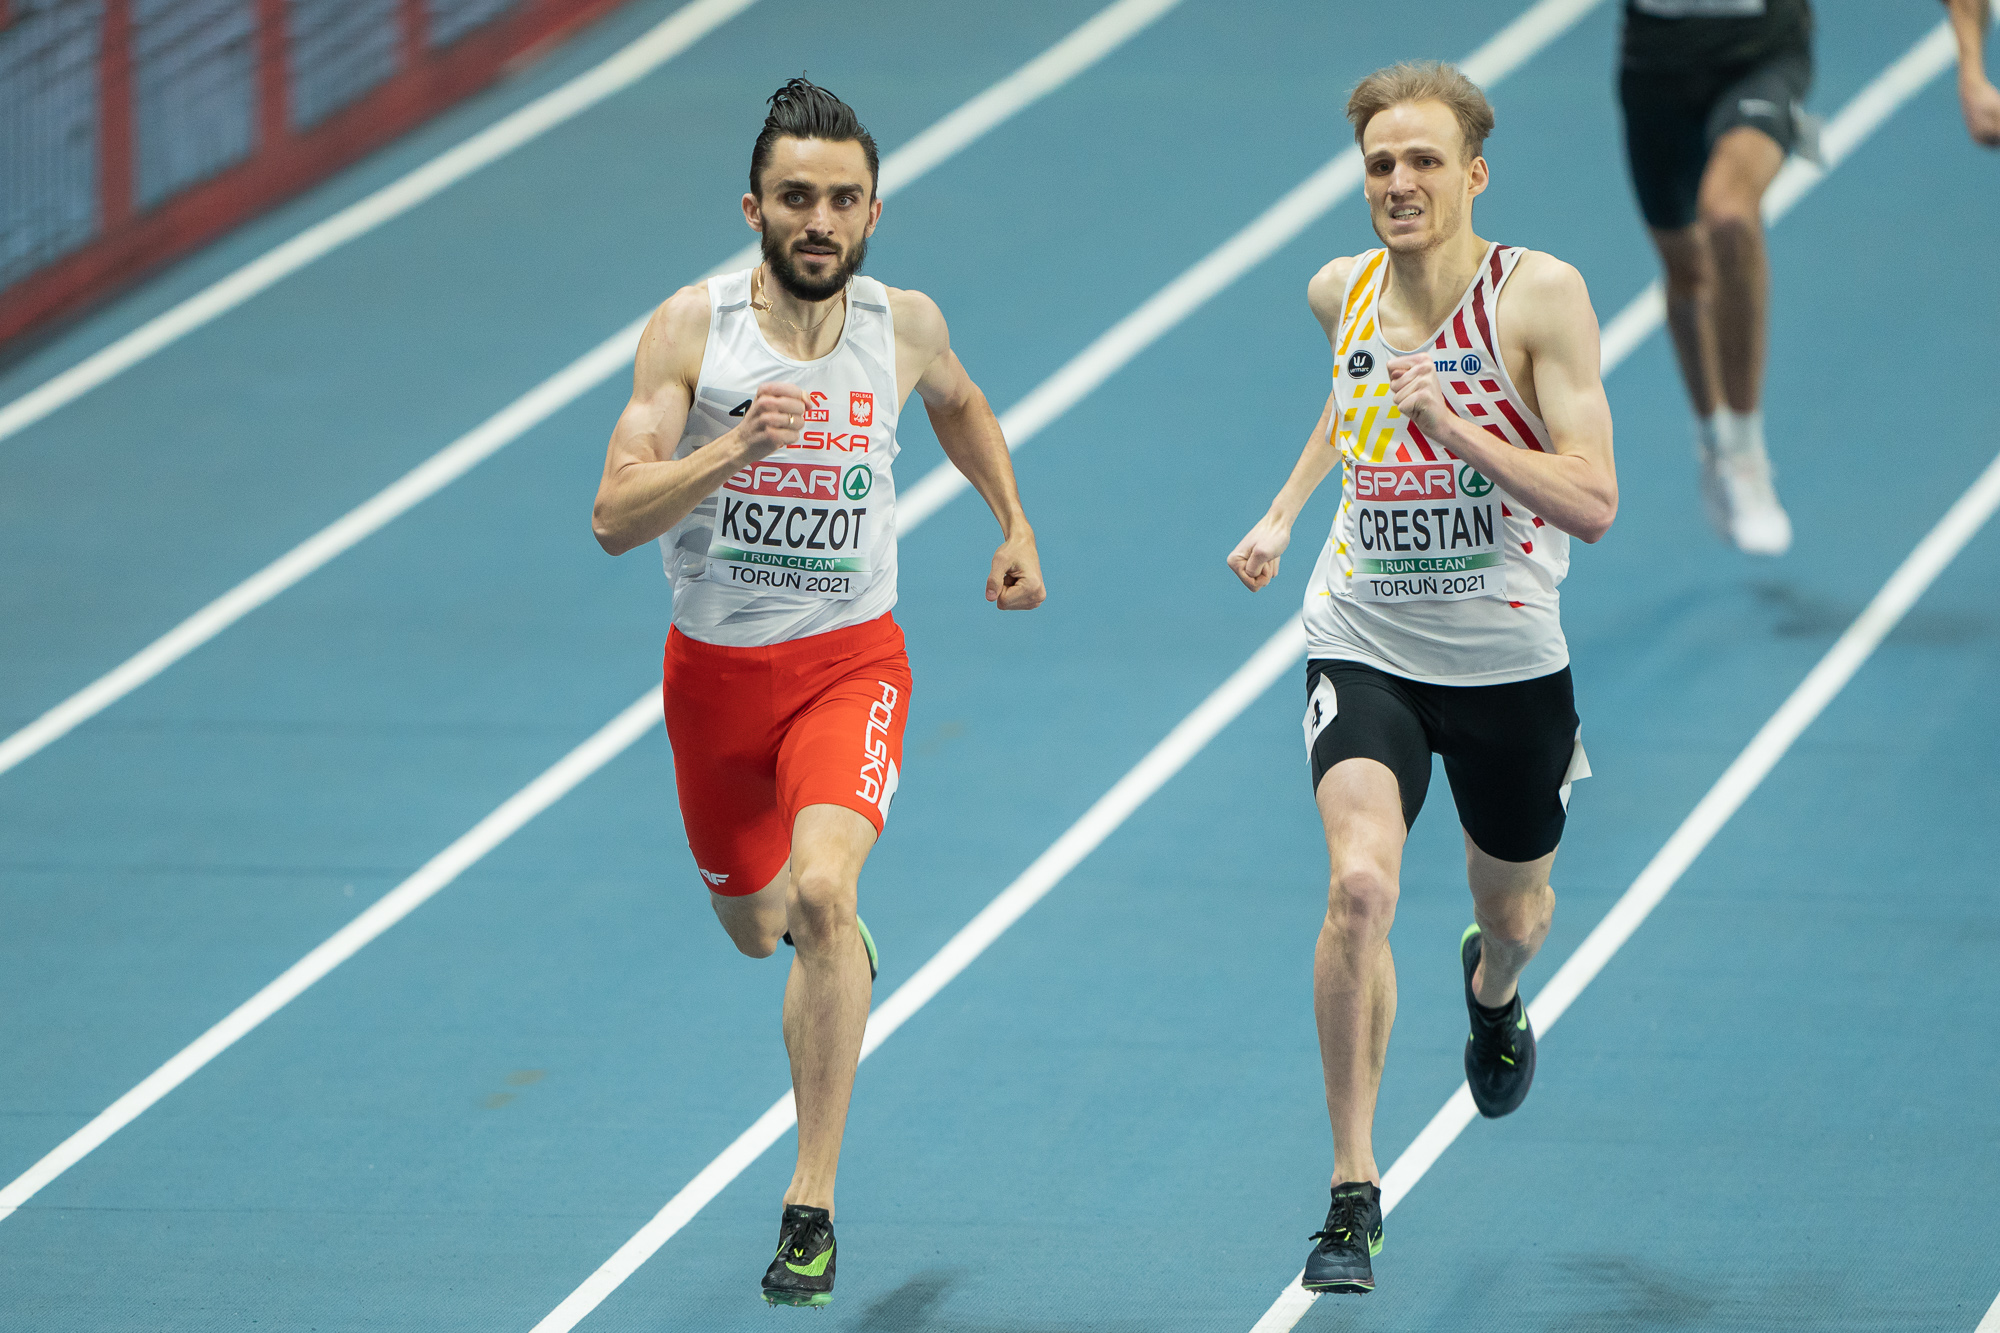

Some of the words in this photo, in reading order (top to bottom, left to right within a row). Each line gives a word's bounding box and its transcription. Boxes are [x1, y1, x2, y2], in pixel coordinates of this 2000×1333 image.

[729, 398, 752, 417] 4
[804, 411, 827, 421] LEN
[727, 465, 837, 496] SPAR
[1357, 469, 1453, 496] SPAR
[721, 497, 867, 551] KSZCZOT
[1359, 504, 1495, 552] CRESTAN
[743, 552, 747, 561] I
[751, 554, 783, 565] RUN
[1380, 561, 1384, 572] I
[1386, 560, 1415, 573] RUN
[729, 566, 801, 589] TORUŃ
[805, 577, 850, 593] 2021
[1370, 576, 1438, 597] TORUŃ
[1442, 574, 1485, 595] 2021
[855, 680, 898, 804] POLSKA
